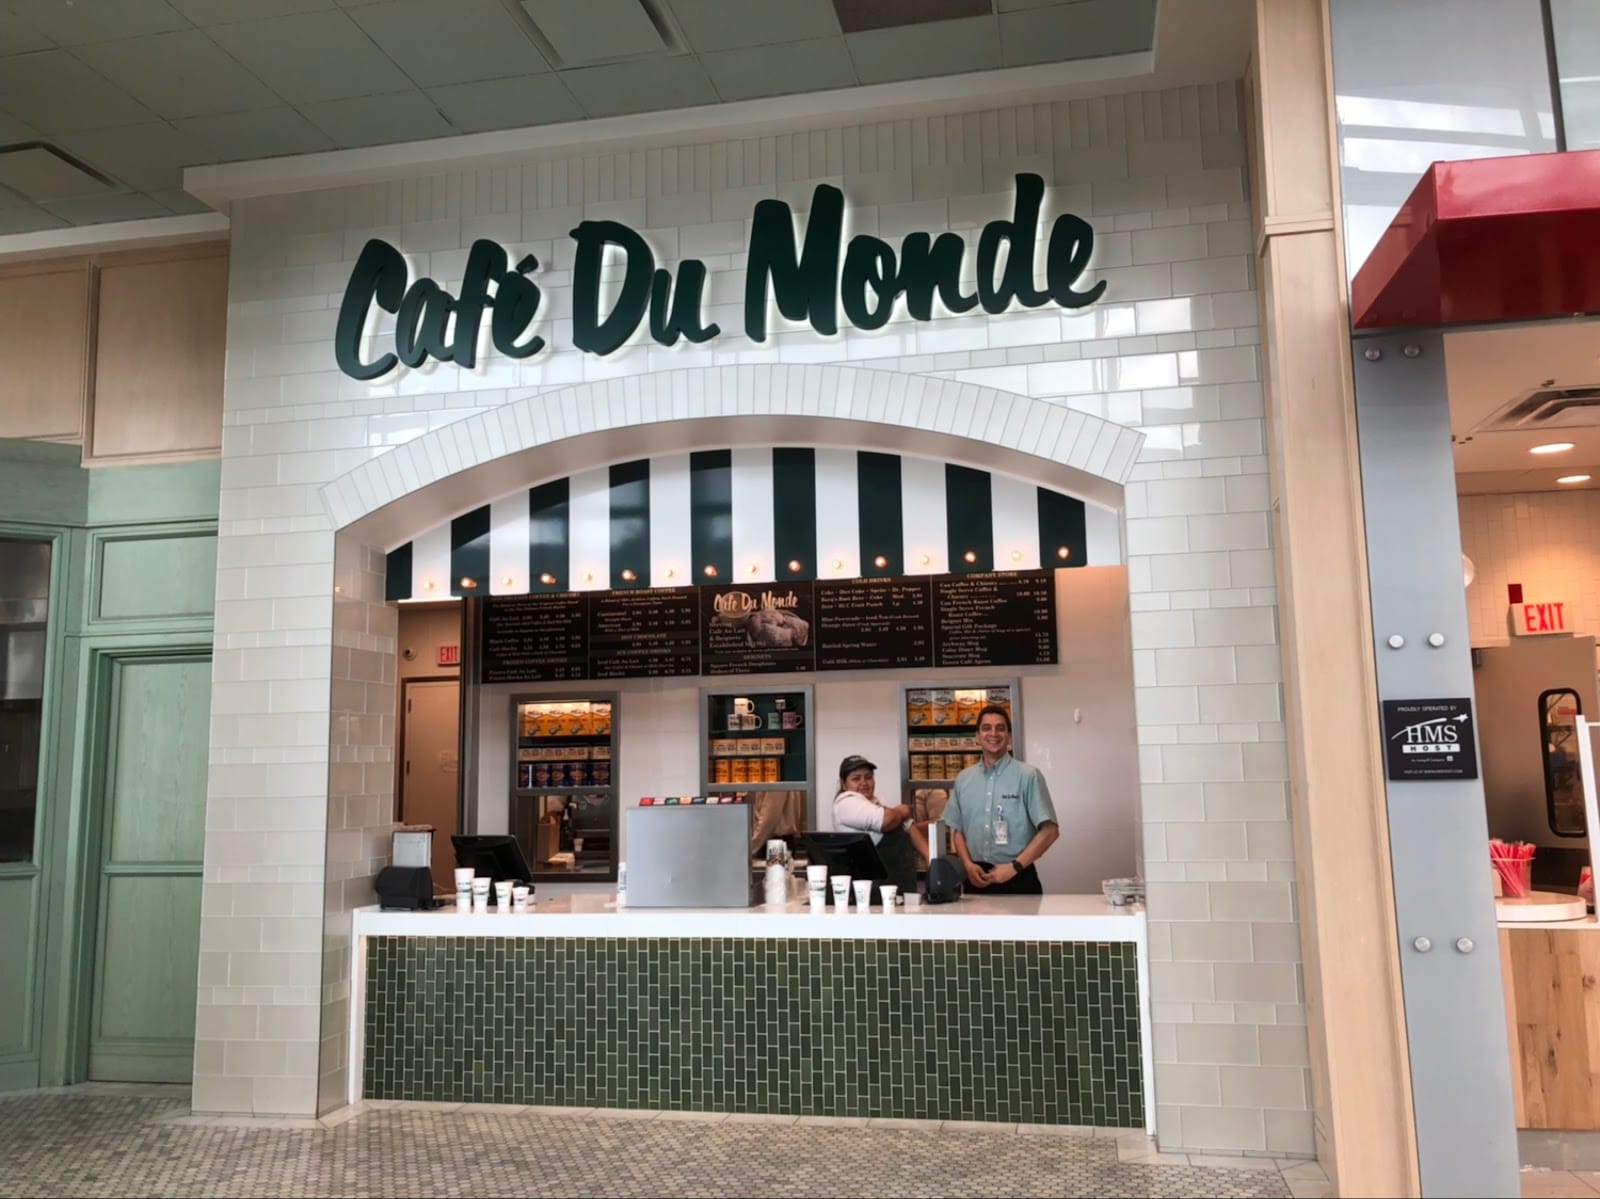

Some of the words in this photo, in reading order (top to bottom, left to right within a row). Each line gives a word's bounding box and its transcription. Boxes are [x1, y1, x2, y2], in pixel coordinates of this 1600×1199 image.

[334, 238, 544, 381] Café
[569, 219, 721, 356] Du
[745, 172, 1107, 343] Monde
[1524, 603, 1564, 631] EXIT
[440, 646, 459, 662] EXIT
[1406, 725, 1458, 743] HMS
